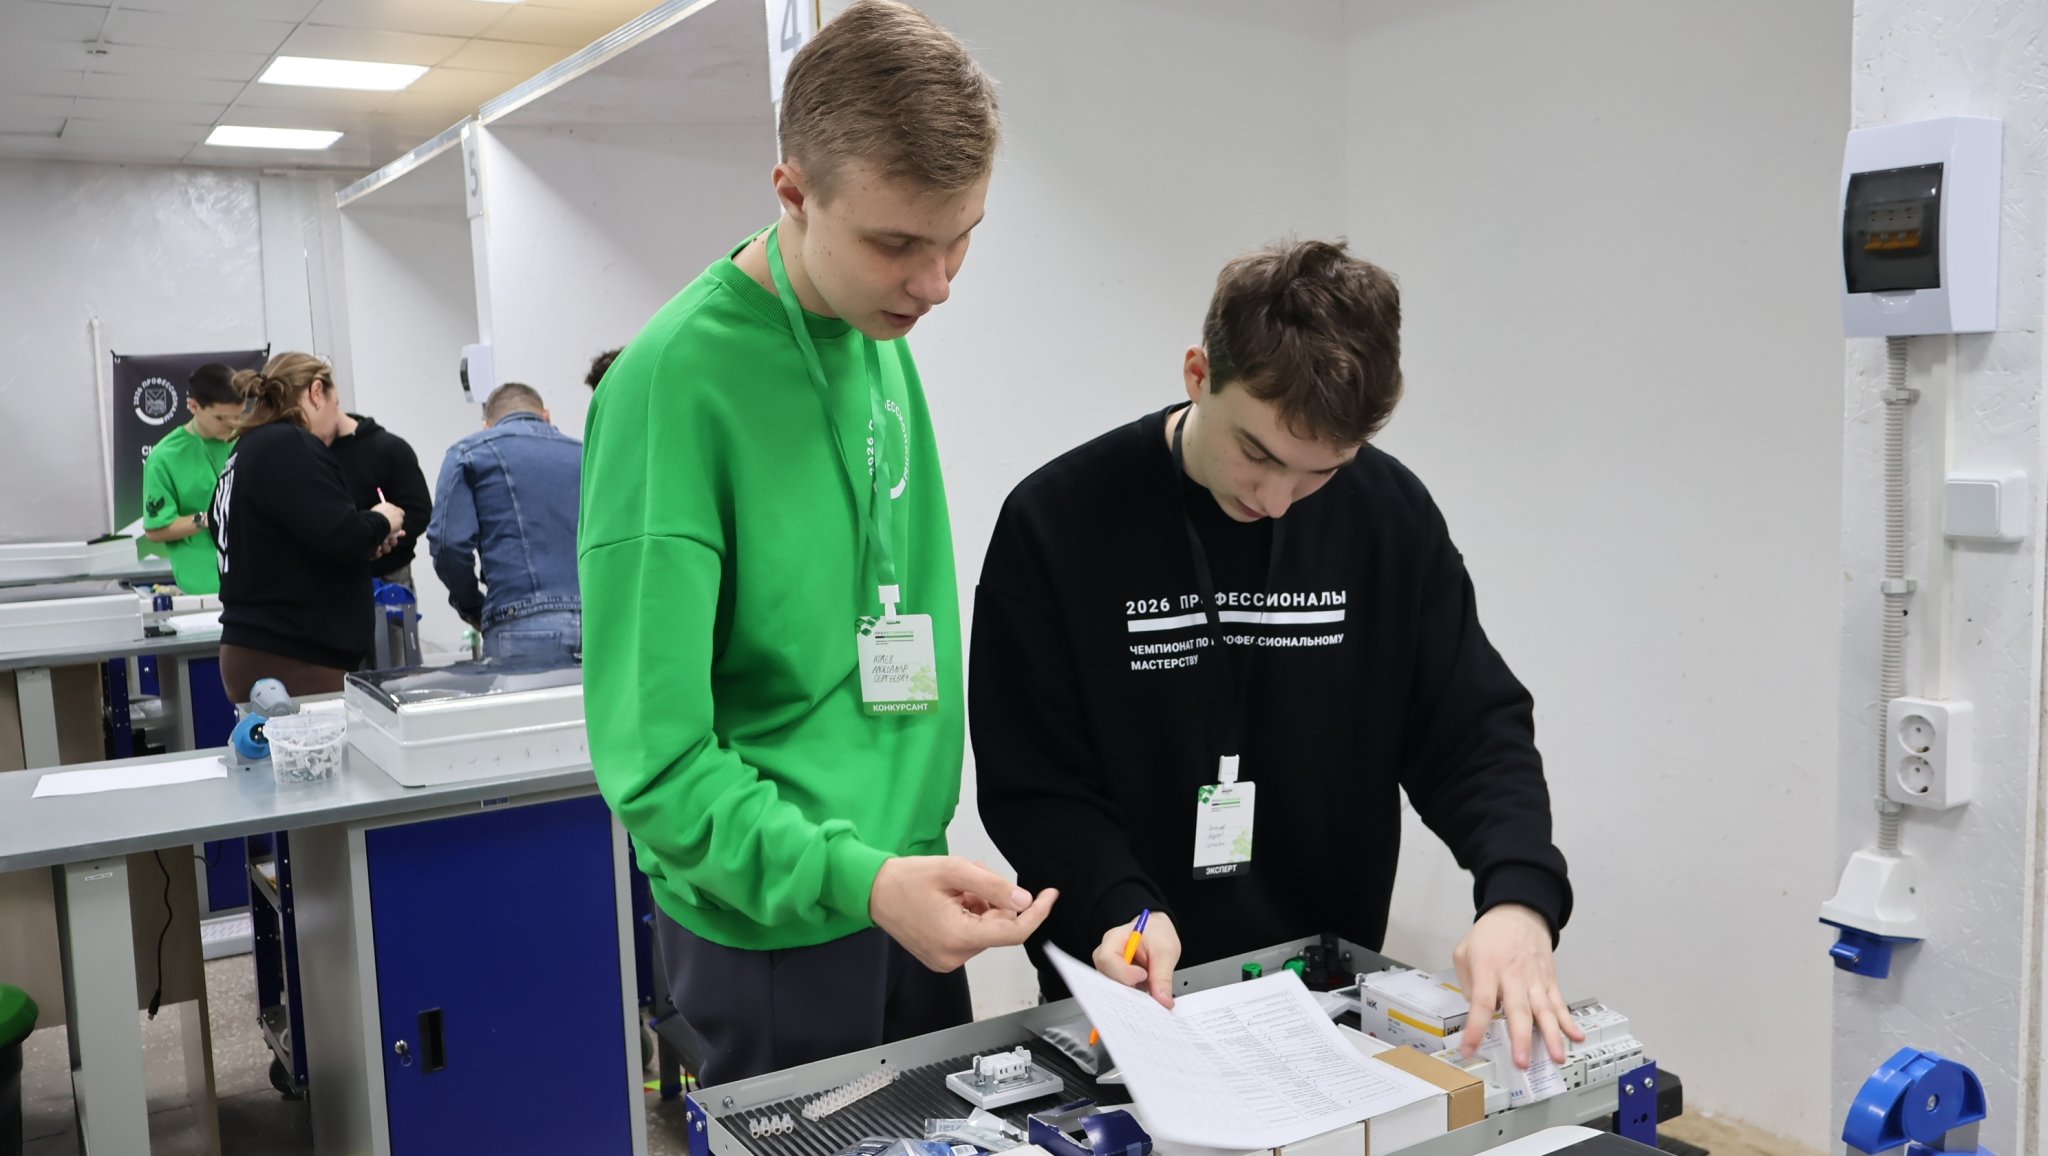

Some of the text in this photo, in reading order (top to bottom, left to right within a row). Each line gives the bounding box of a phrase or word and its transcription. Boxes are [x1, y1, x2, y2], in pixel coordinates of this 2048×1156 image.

[780, 0, 801, 52] 4
[469, 150, 479, 198] 5
[866, 437, 875, 476] 2026
[1125, 590, 1347, 615] 2026 ПРФЕССИОНАЛЫ
[1129, 639, 1195, 656] ЧЕМПИОНАТ
[1195, 636, 1209, 648] ПО
[1130, 654, 1199, 671] МАСТЕРСТВУ
[872, 703, 929, 712] КОНКУРСАНТ
[1205, 864, 1238, 875] ЭКСПЕРТ
